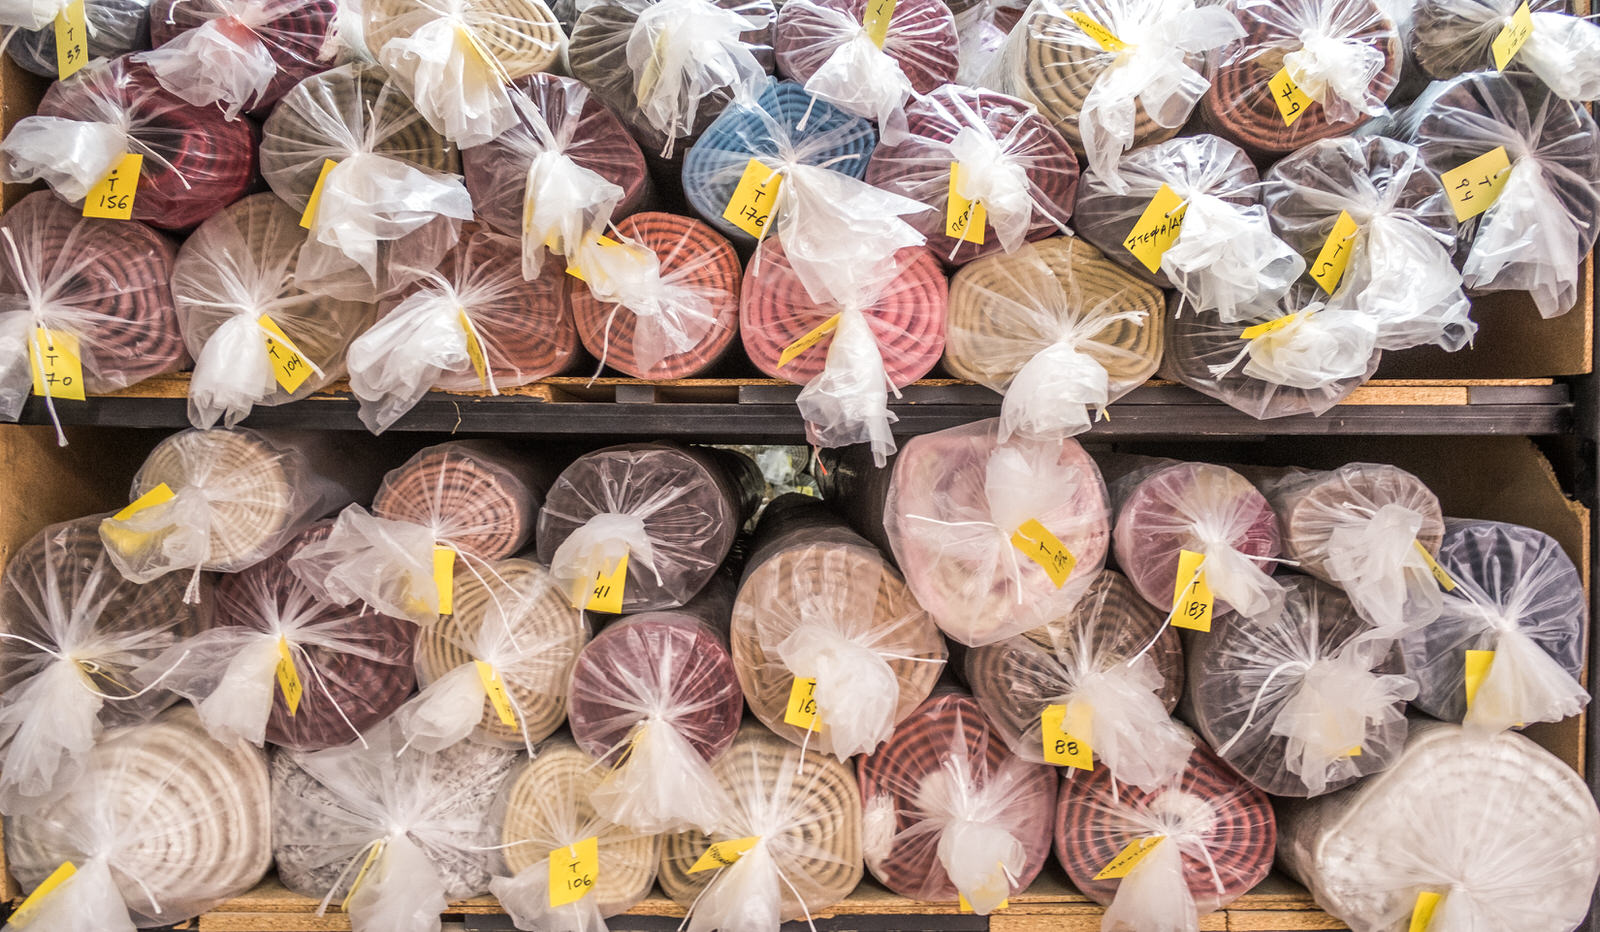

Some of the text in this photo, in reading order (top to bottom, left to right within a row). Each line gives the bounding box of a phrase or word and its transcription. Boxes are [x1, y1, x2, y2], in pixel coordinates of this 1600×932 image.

[67, 27, 74, 42] T
[66, 44, 81, 65] 33
[106, 177, 120, 192] T
[1474, 176, 1491, 188] T
[753, 189, 767, 203] T
[1455, 178, 1474, 203] 94
[99, 195, 130, 211] 156
[737, 205, 769, 228] 176
[1333, 243, 1344, 258] T
[268, 345, 281, 360] T
[46, 355, 60, 367] T
[282, 352, 304, 378] 104
[45, 372, 74, 387] 70
[1039, 540, 1052, 556] T
[593, 584, 611, 599] 41
[1190, 581, 1201, 595] T
[1183, 601, 1208, 621] 183
[807, 681, 817, 696] T
[1054, 738, 1080, 757] 88
[568, 860, 582, 874] T
[567, 873, 593, 891] 106
